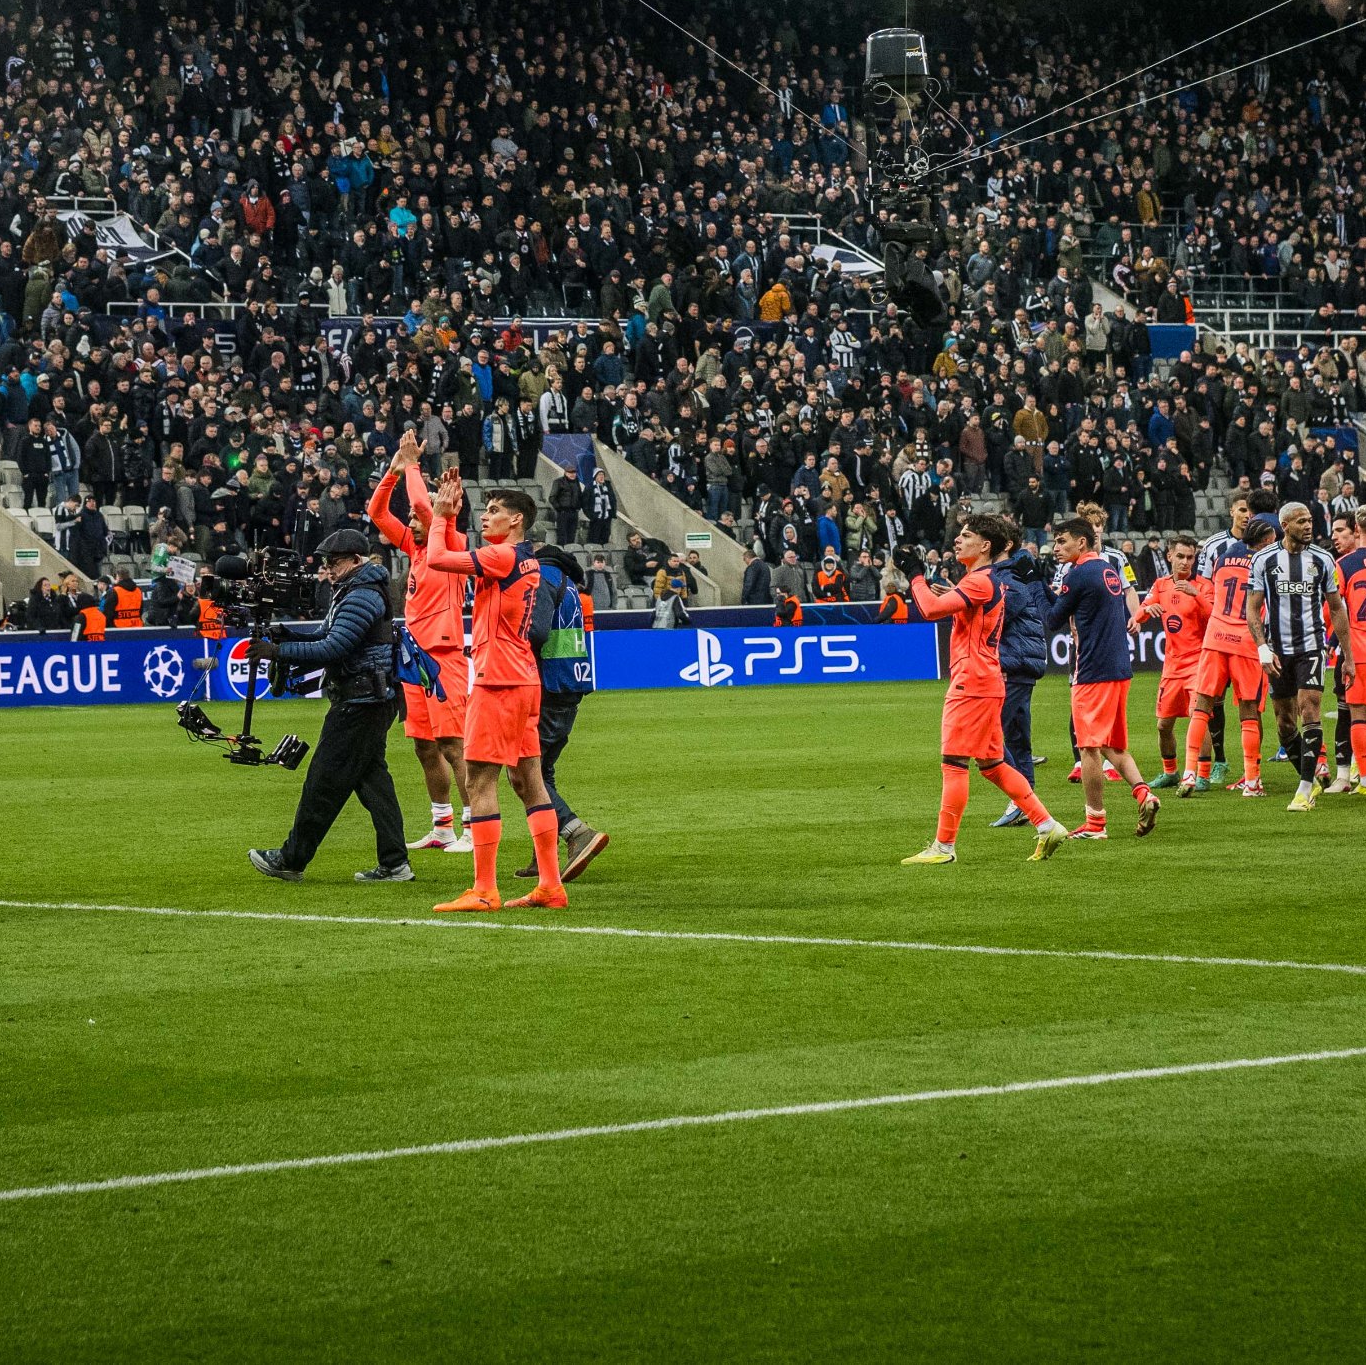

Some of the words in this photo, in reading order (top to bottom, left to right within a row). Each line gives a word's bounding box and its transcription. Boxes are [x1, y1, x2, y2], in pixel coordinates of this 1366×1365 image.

[1224, 557, 1253, 567] RAPHI
[743, 635, 859, 676] PS5
[231, 662, 268, 676] PES
[573, 662, 592, 682] 02
[1309, 657, 1319, 675] 7
